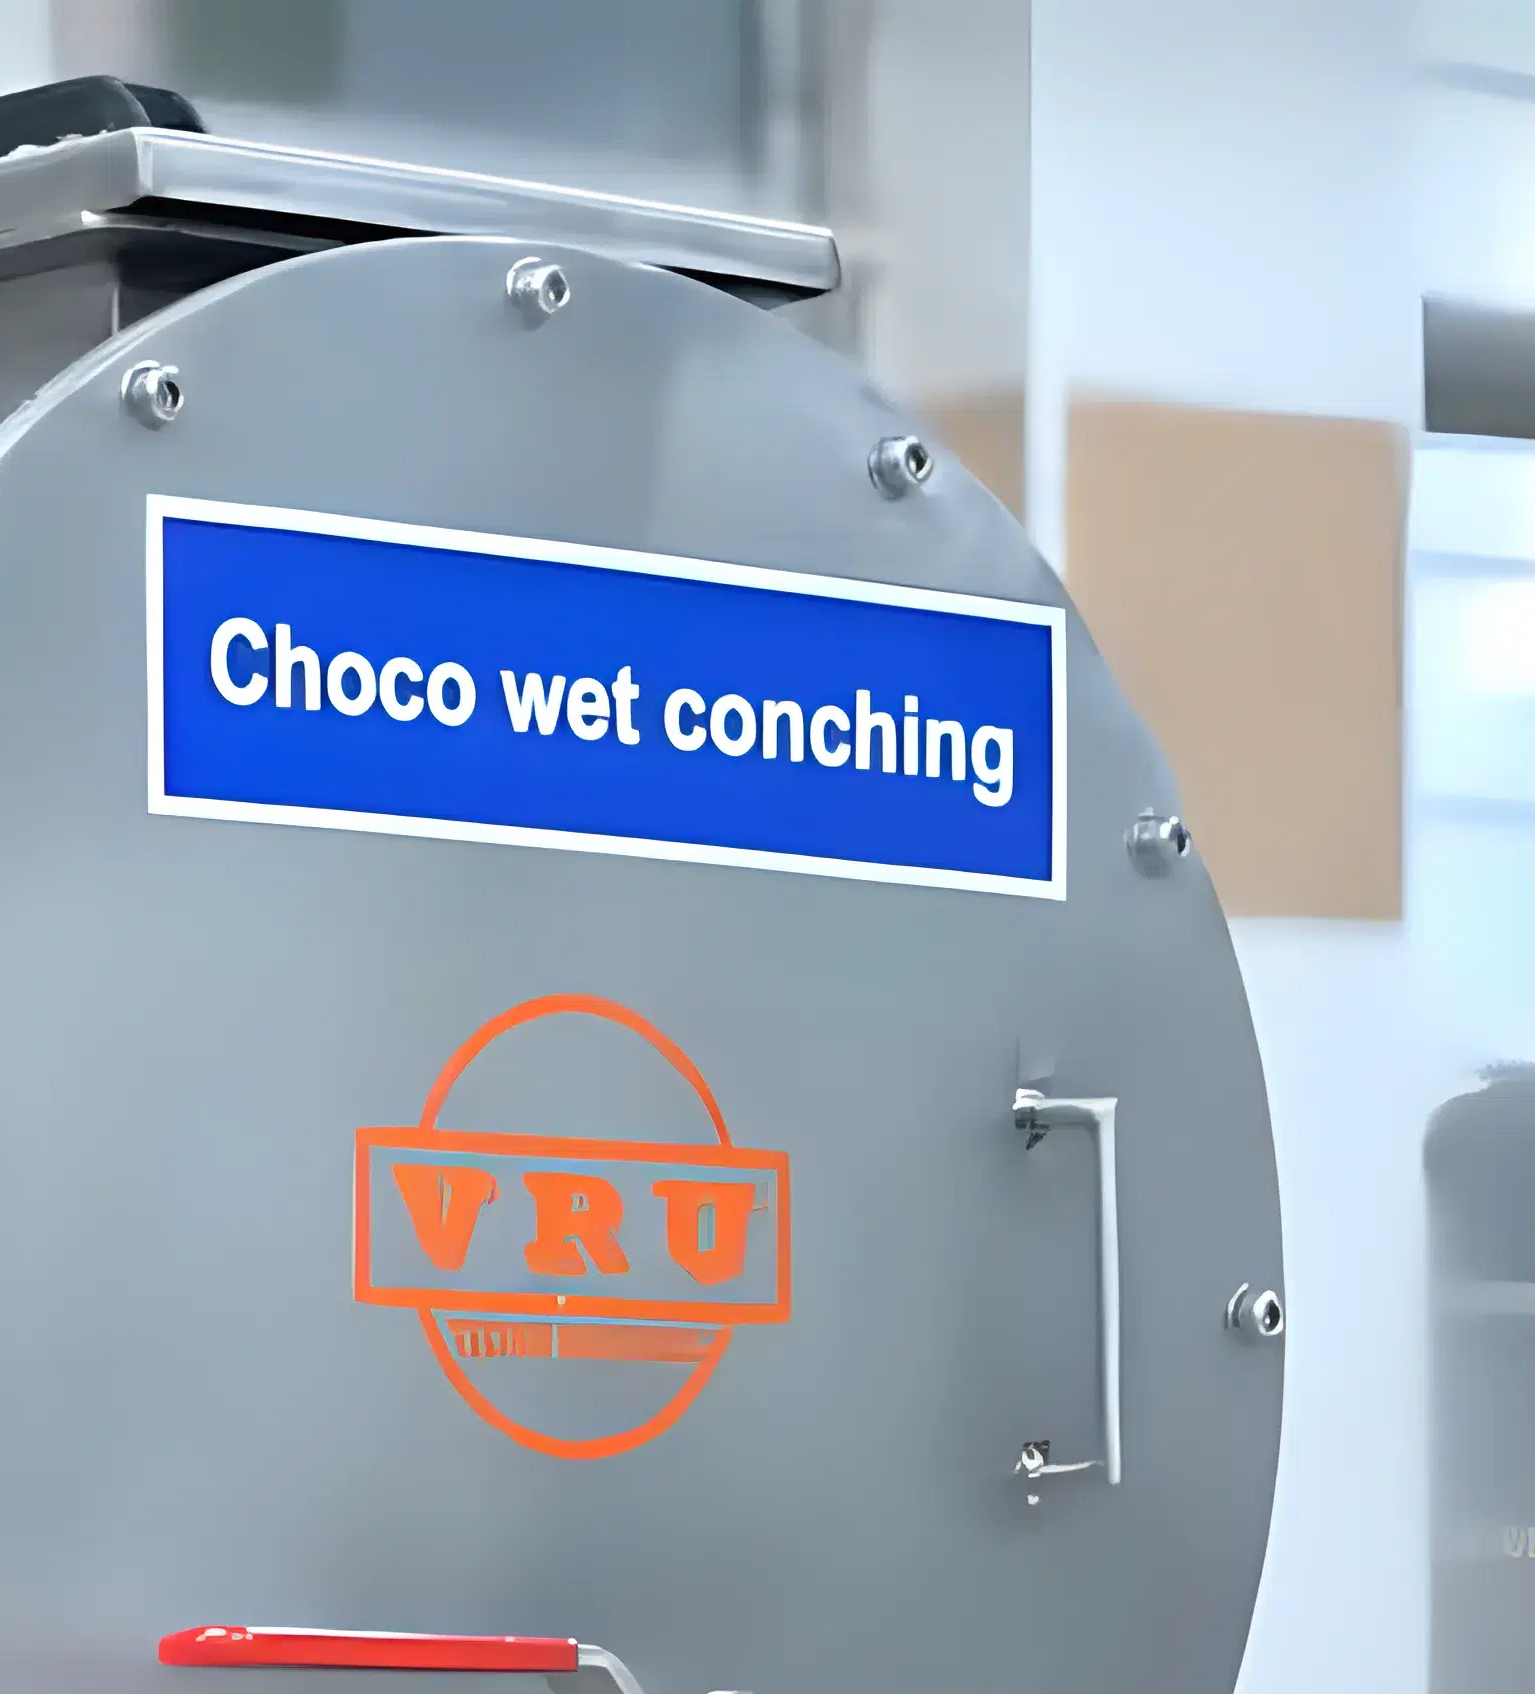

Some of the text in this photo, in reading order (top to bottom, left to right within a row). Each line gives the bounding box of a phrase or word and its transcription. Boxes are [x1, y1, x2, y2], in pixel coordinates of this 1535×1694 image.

[208, 616, 1016, 808] Choco wet conching
[391, 1162, 770, 1286] VRU
